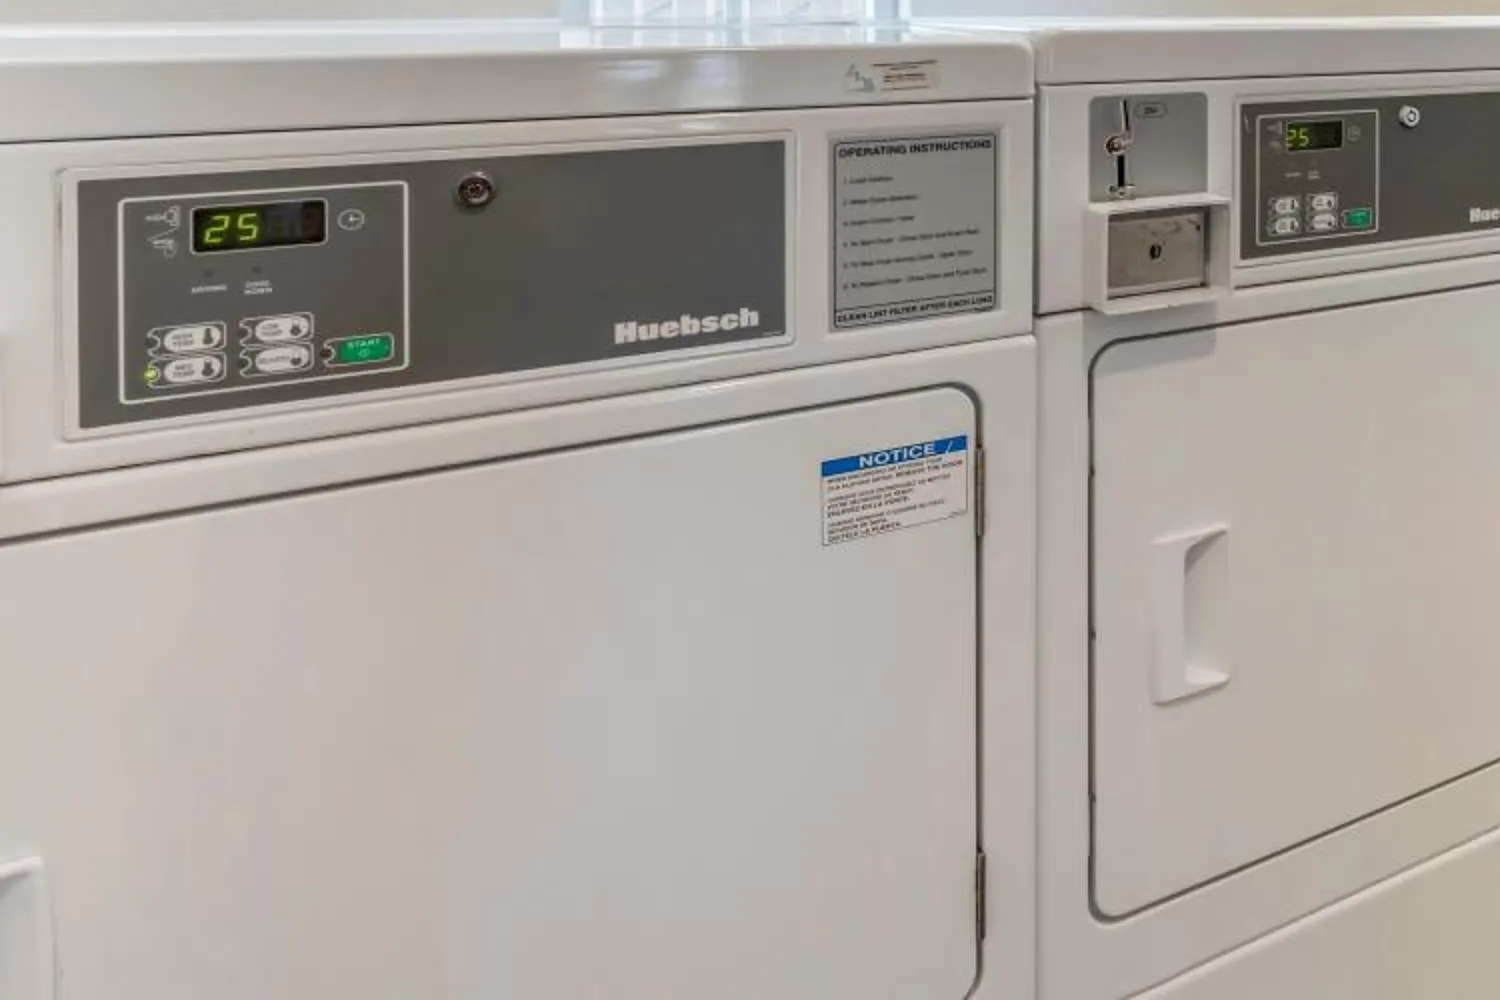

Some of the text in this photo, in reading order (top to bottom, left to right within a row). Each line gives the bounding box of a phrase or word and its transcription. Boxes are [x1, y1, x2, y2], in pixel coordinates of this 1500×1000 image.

[838, 139, 993, 159] OPERATING INSTRUCTIONS
[1286, 127, 1310, 149] 25
[203, 212, 260, 245] 25
[614, 307, 760, 345] Huebsch
[347, 337, 381, 350] START
[858, 443, 936, 468] NOTICE
